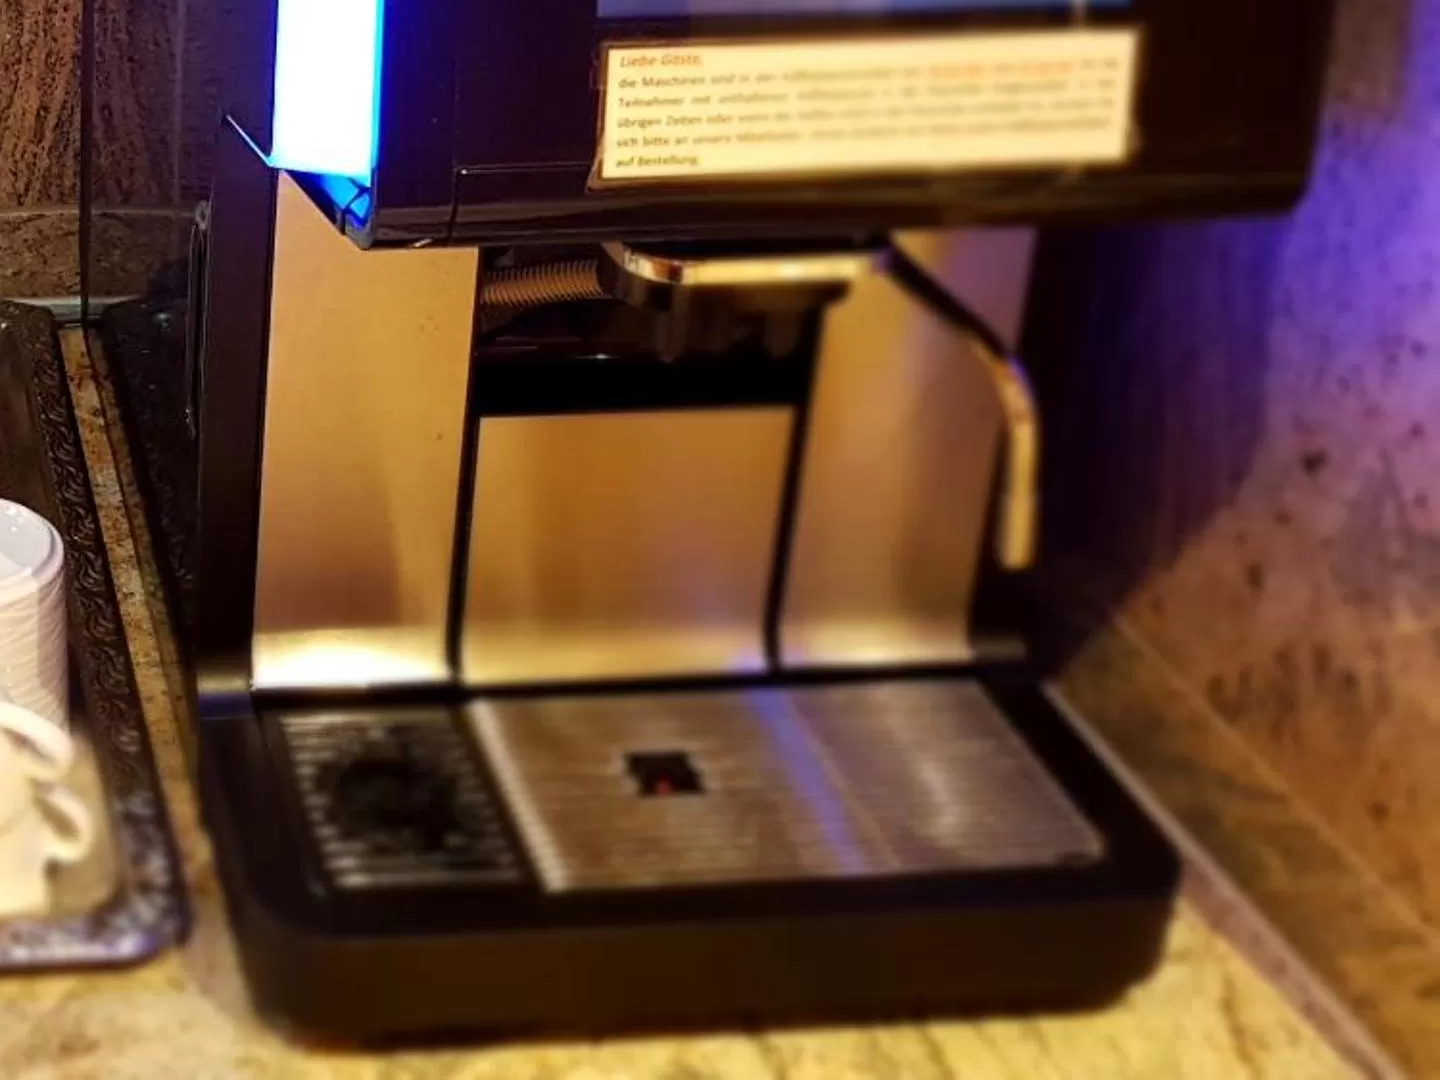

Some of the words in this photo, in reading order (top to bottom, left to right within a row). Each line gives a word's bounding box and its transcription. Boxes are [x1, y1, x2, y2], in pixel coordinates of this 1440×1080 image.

[620, 55, 657, 68] Liebe
[618, 78, 637, 88] die
[642, 76, 705, 88] Maschinen
[616, 156, 634, 168] auf
